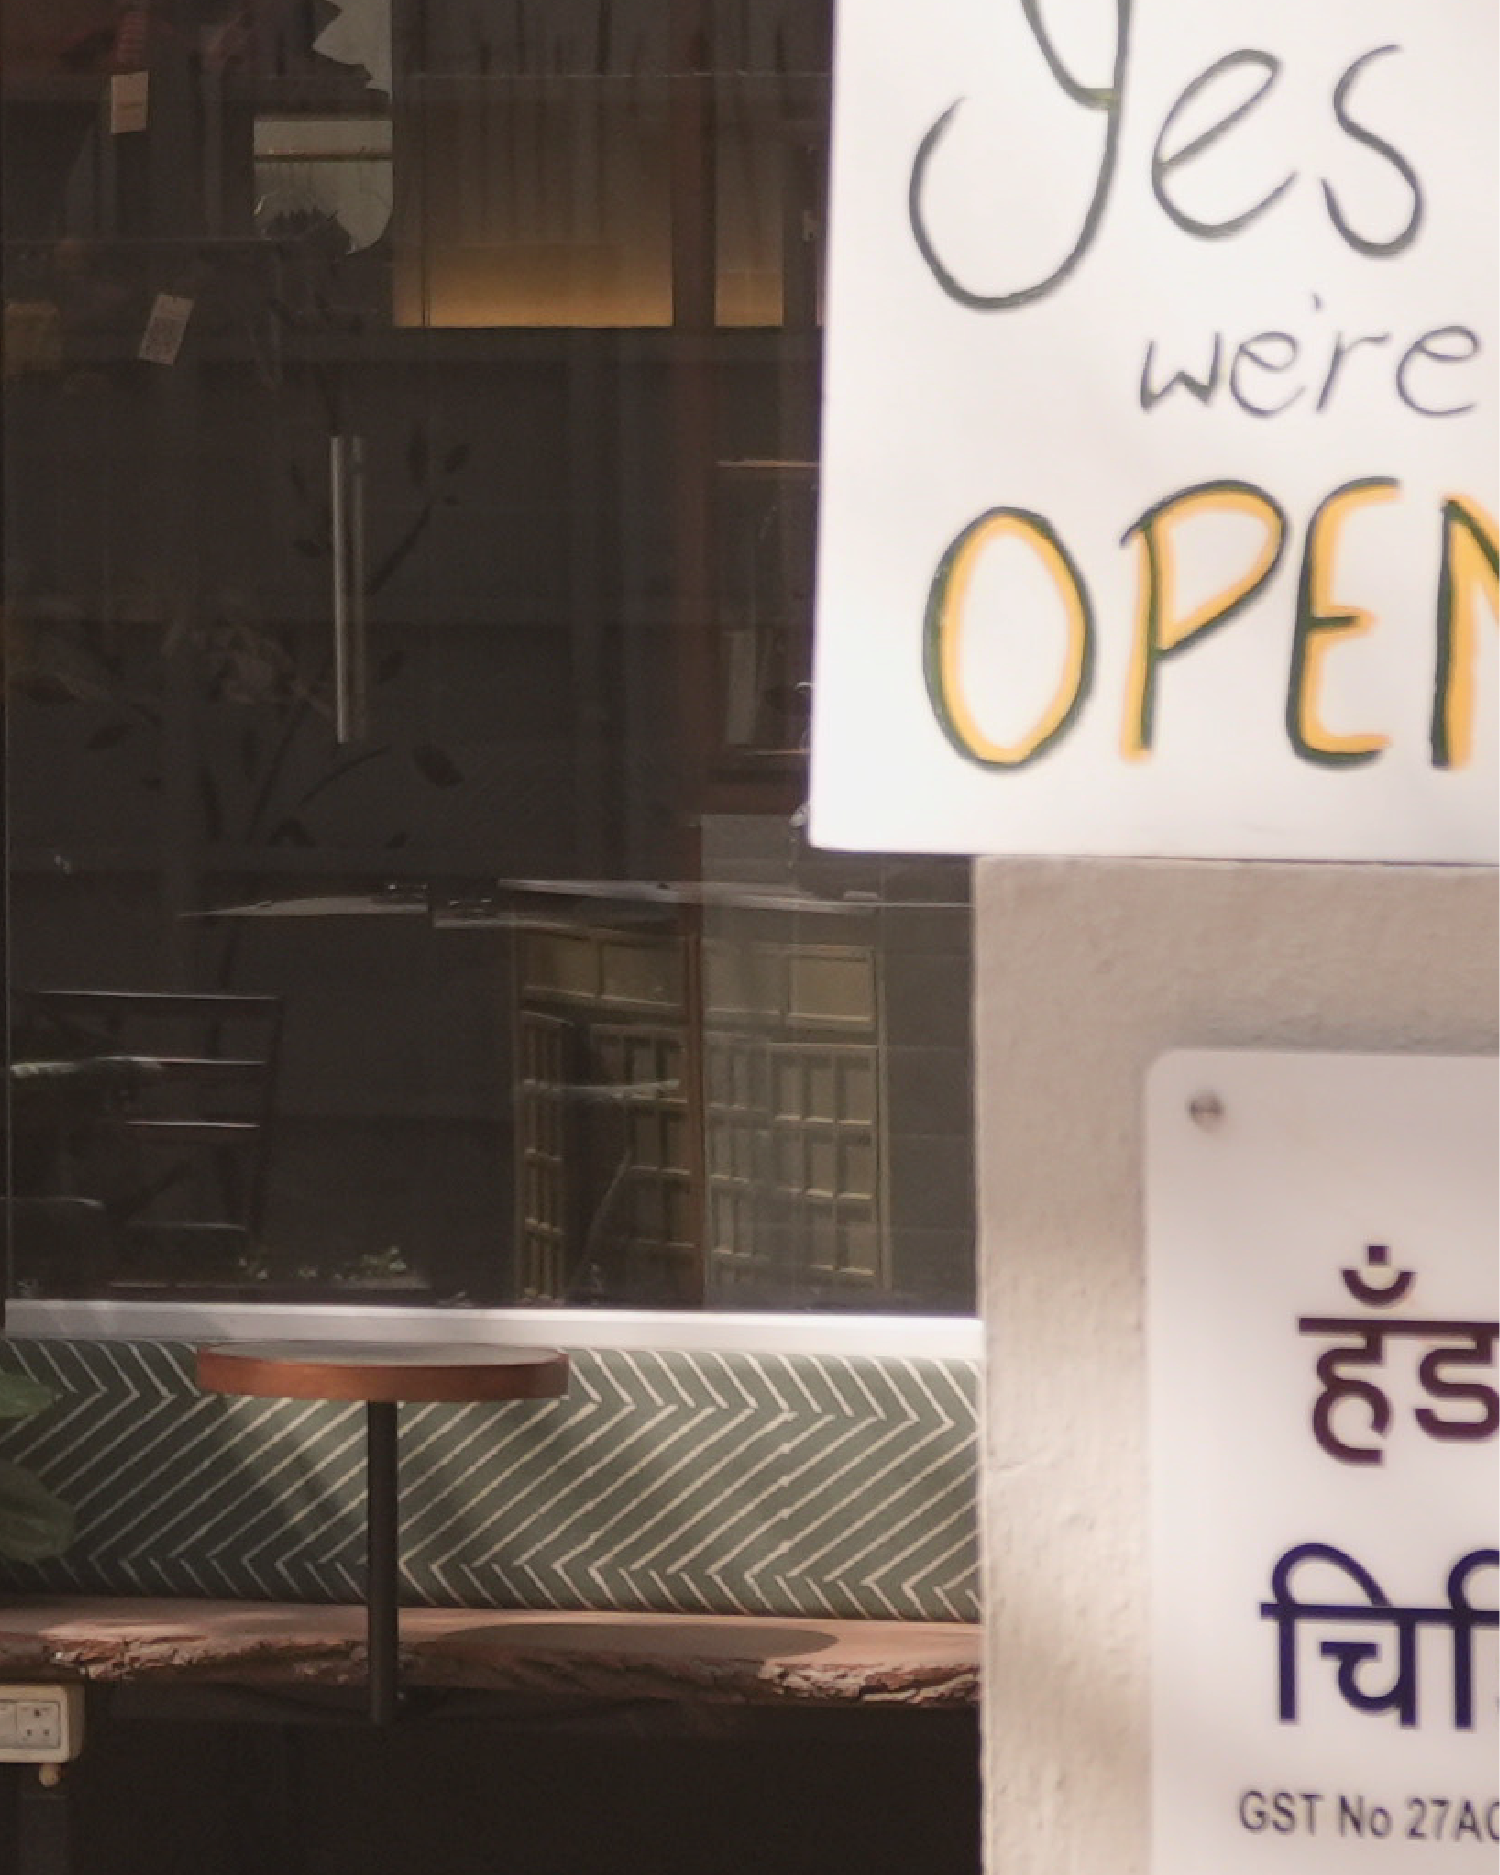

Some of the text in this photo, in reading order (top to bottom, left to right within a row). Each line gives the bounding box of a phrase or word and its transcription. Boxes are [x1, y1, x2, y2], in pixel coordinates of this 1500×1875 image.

[1139, 294, 1481, 418] we're
[1239, 1790, 1325, 1834] GST
[1337, 1794, 1393, 1839] No
